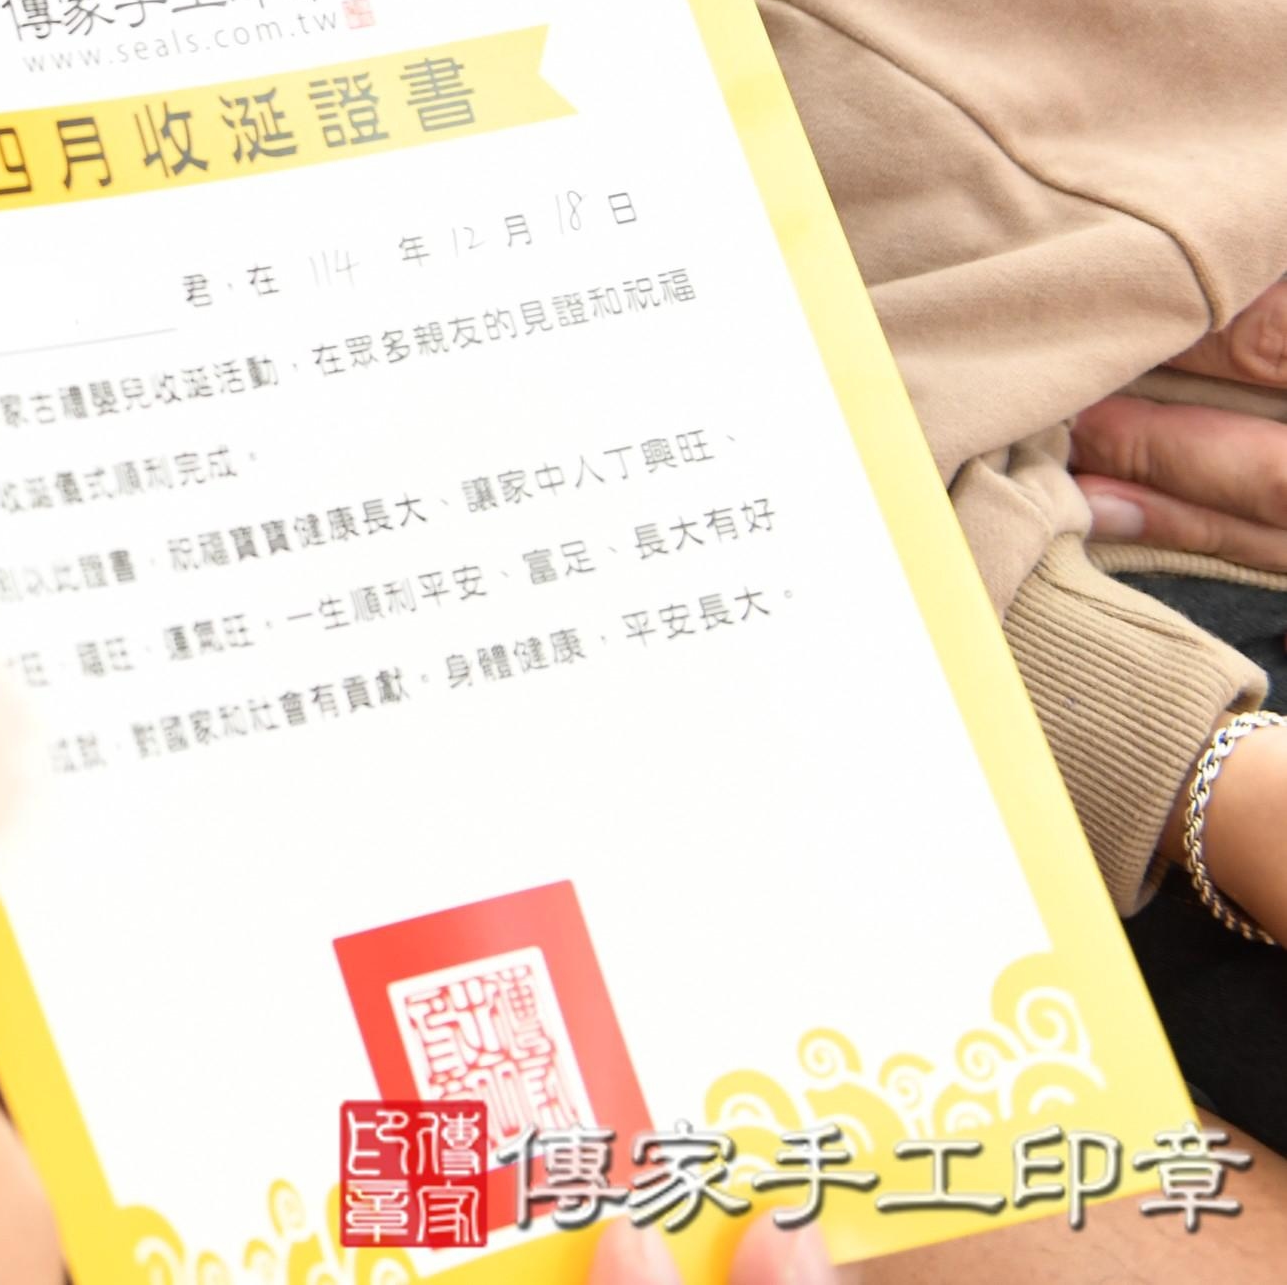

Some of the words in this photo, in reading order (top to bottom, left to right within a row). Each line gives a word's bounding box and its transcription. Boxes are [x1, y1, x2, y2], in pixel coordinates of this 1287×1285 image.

[23, 8, 337, 74] www.seals.com.tw
[397, 235, 431, 267] 年
[450, 225, 485, 258] 12
[503, 213, 534, 248] 月
[554, 189, 587, 236] 18
[606, 190, 639, 226] 日
